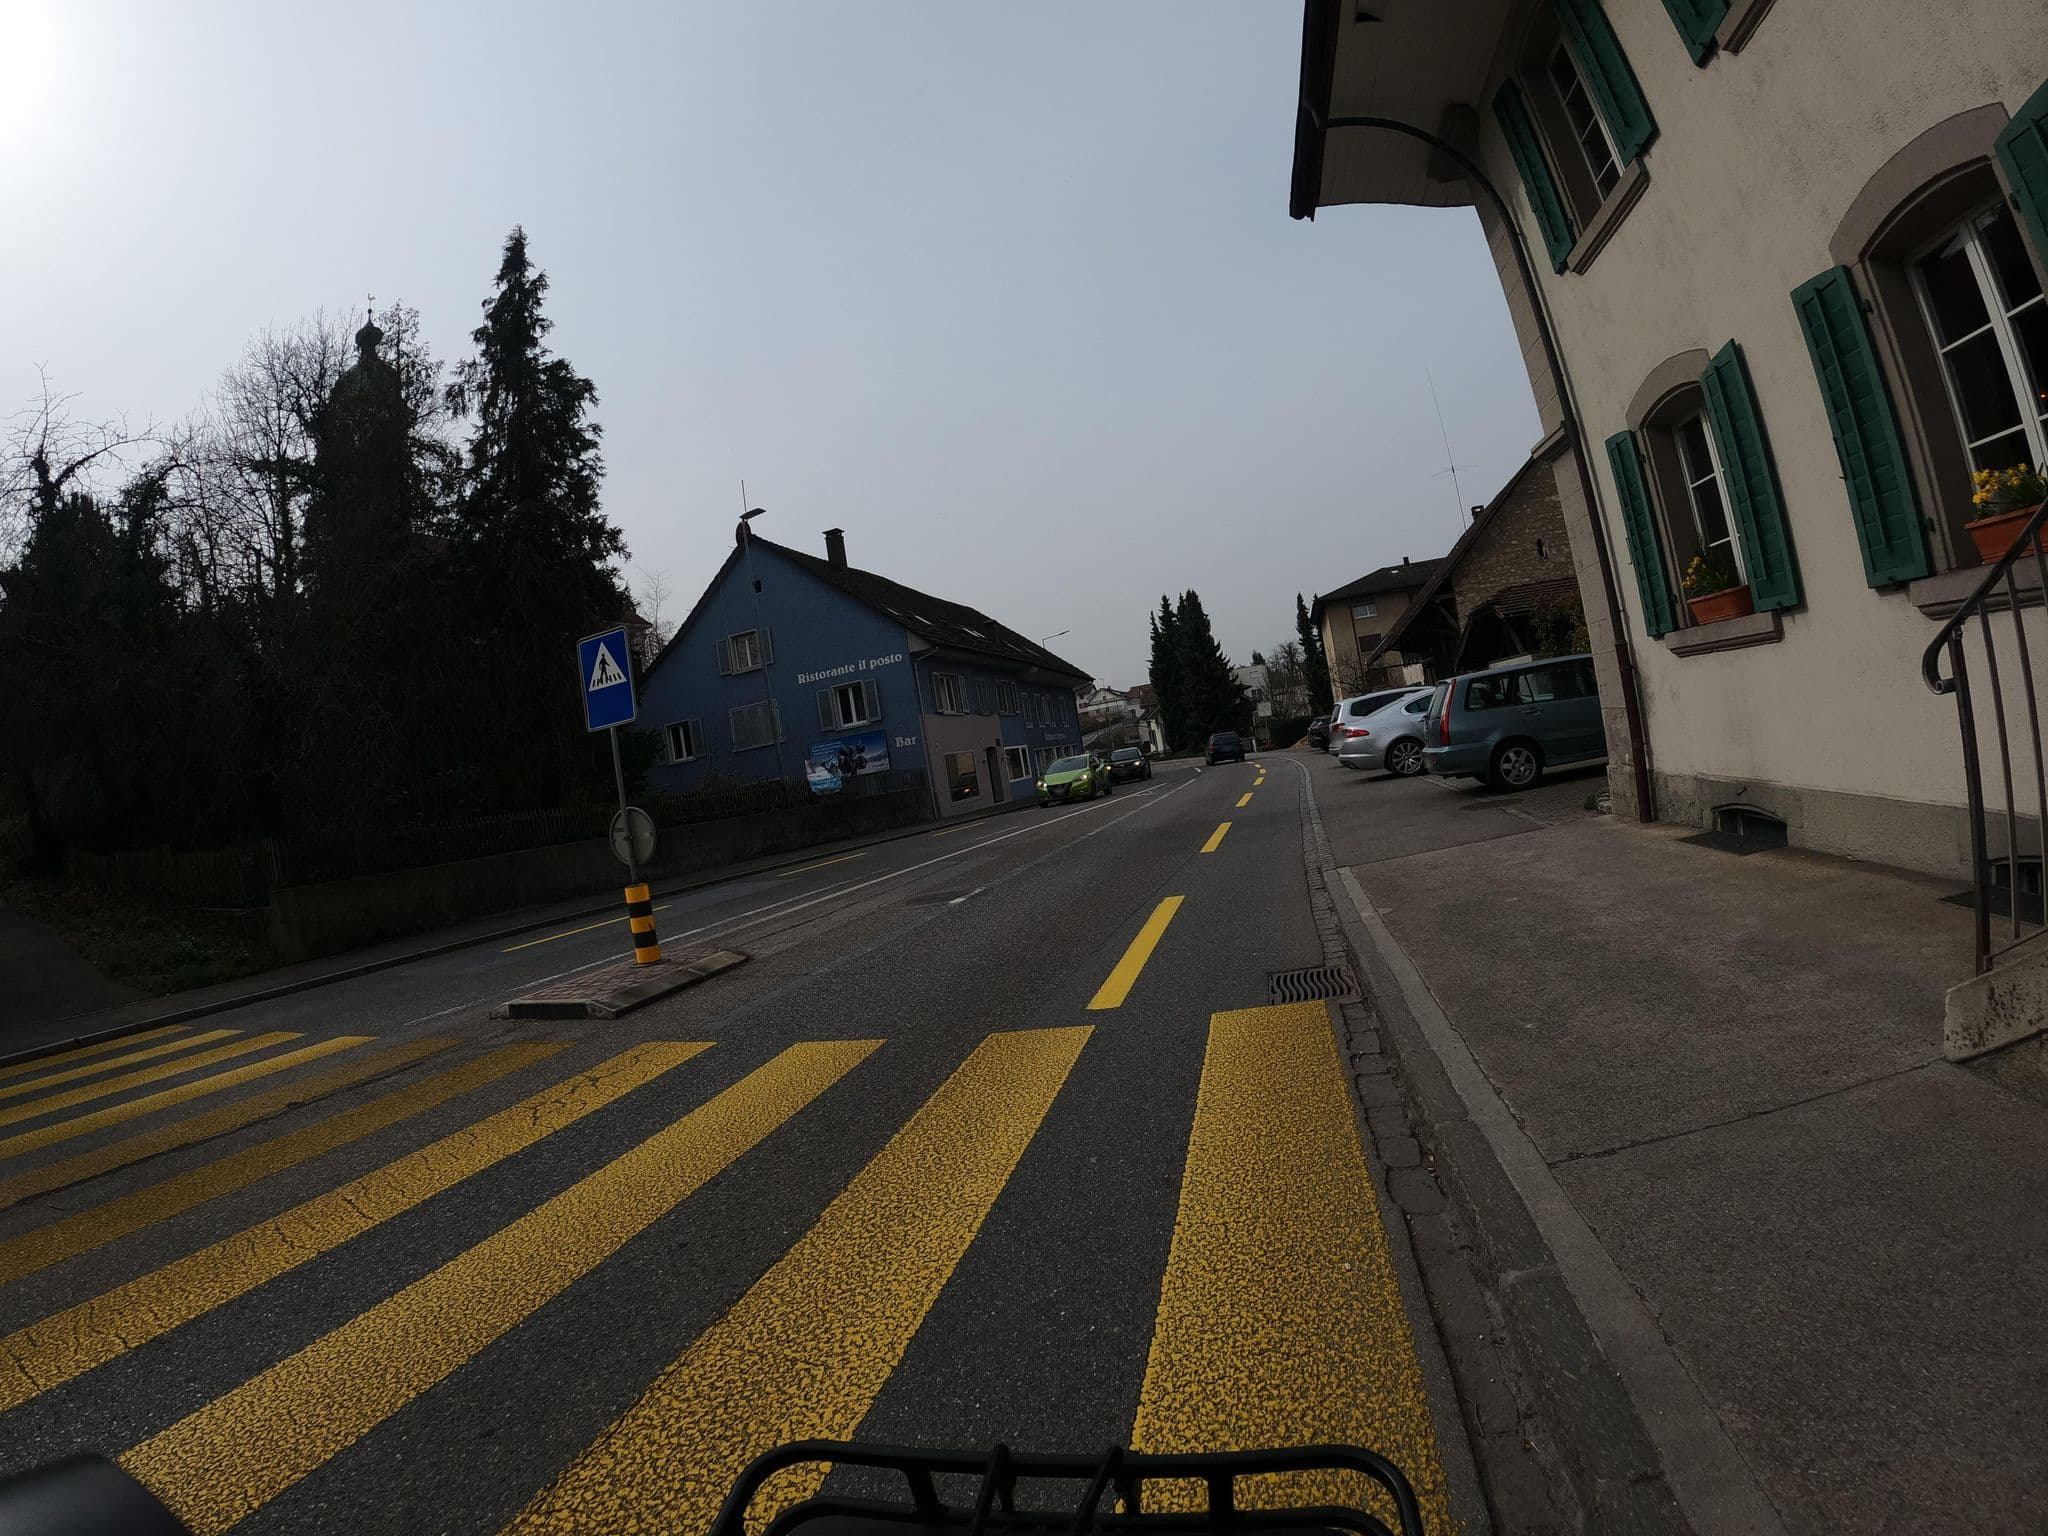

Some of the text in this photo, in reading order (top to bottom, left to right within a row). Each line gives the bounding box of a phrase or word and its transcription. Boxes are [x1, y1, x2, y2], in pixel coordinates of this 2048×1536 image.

[797, 653, 903, 684] Ristorante il posto
[895, 736, 917, 748] Bar
